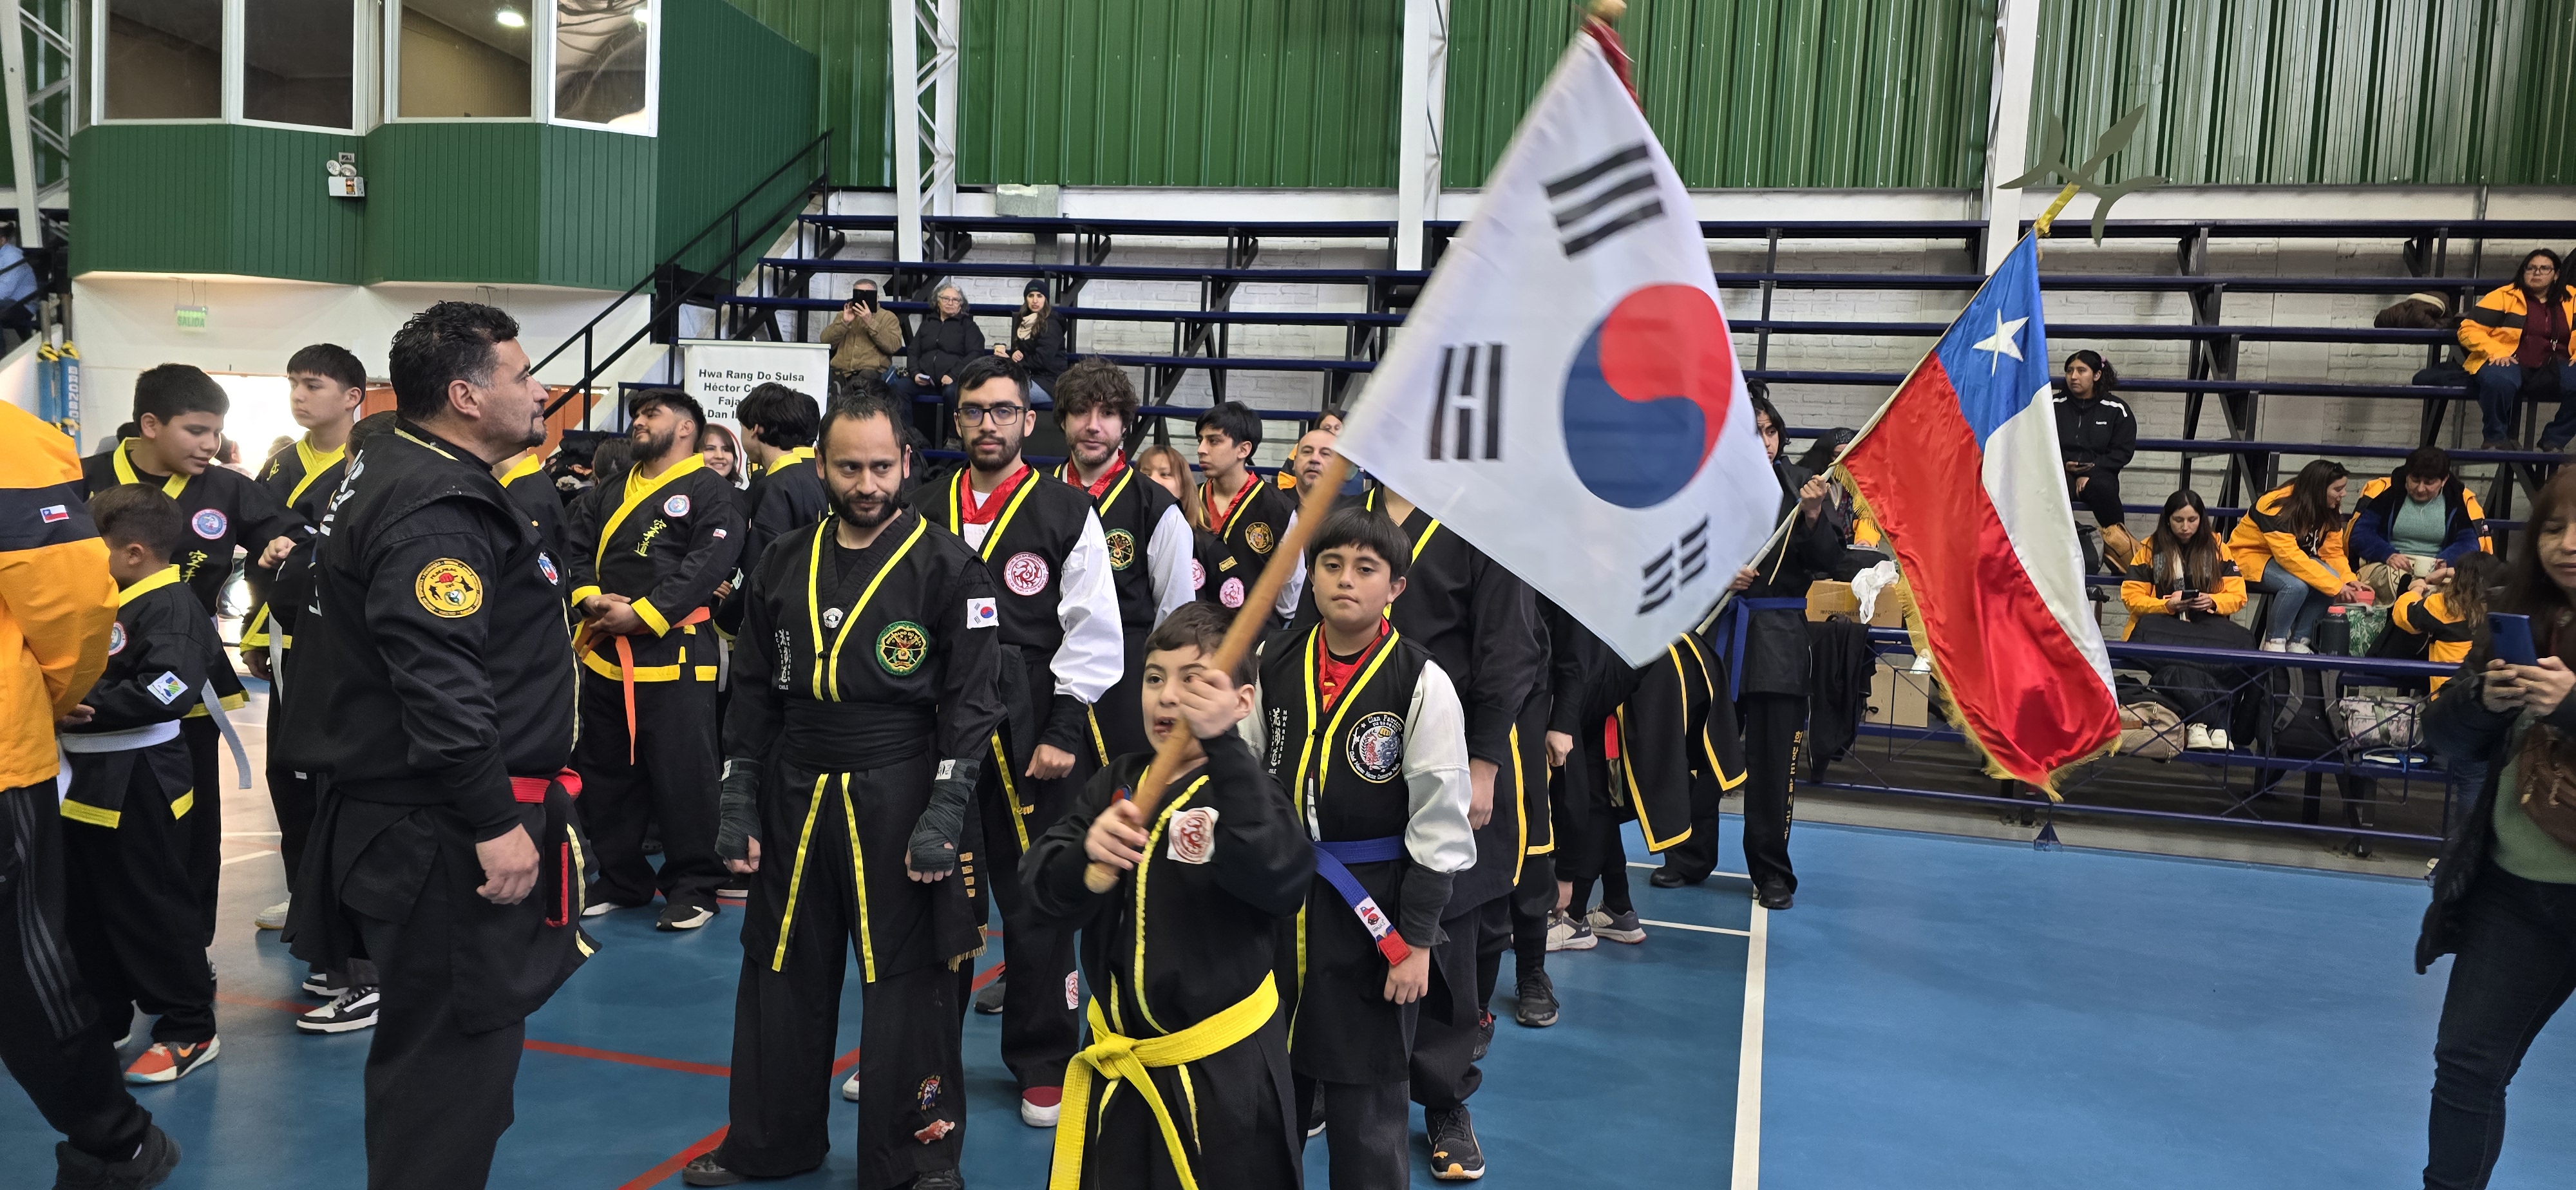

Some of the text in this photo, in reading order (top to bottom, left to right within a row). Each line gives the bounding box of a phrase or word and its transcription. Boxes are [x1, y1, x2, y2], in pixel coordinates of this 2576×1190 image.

[177, 316, 205, 328] SALIDA
[699, 368, 804, 381] Hwa Rang Do Sulsa
[704, 382, 740, 392] Héctor
[718, 397, 741, 407] Faja
[708, 410, 728, 419] Dan
